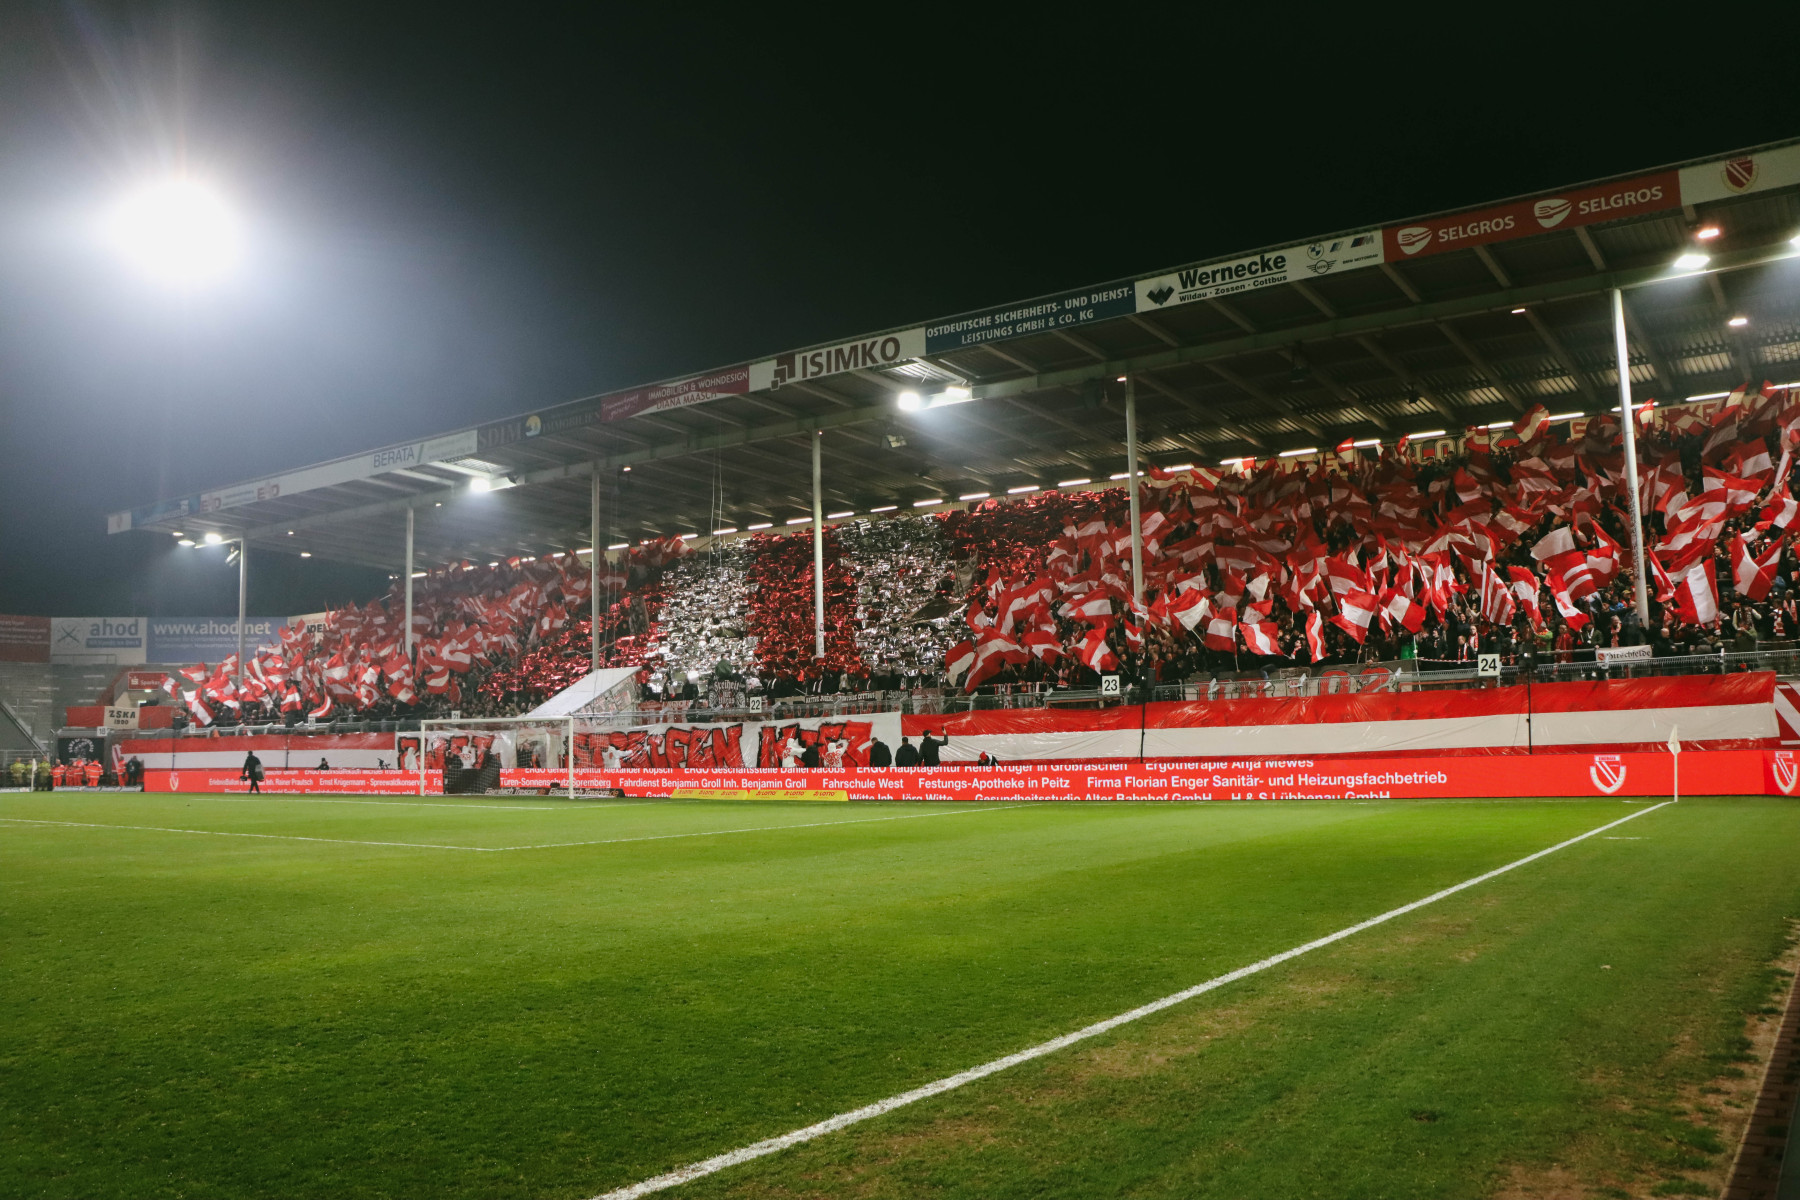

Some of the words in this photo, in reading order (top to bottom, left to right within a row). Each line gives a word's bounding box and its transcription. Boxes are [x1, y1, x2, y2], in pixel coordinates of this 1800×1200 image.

[1580, 186, 1663, 215] SELGROS
[1438, 216, 1515, 242] SELGROS
[1178, 254, 1287, 289] Wernecke
[1179, 290, 1208, 302] Wildau
[1214, 283, 1246, 295] Zossen
[1252, 275, 1288, 288] Cottbus
[926, 315, 992, 338] OSTDEUTSCHE
[994, 302, 1062, 324] SICHERHEITS-
[1064, 296, 1088, 310] UND
[1091, 286, 1133, 304] DIENST-
[961, 326, 1013, 345] LEISTUNGS
[1016, 319, 1045, 333] GMBH
[1048, 316, 1055, 327] &
[1058, 313, 1076, 325] CO.
[1079, 309, 1094, 321] KG
[801, 336, 901, 379] ISIMKO
[648, 384, 689, 401] IMMOBILIEN
[691, 382, 696, 391] &
[698, 370, 748, 389] WOHNDESIGN
[656, 399, 682, 410] DIANA
[683, 392, 717, 405] MAASCH
[373, 446, 414, 468] BERATA
[90, 619, 138, 636] ahod
[153, 620, 271, 635] www.ahodnet
[1480, 657, 1498, 672] 24
[1104, 679, 1118, 692] 23
[751, 700, 760, 710] 22
[109, 710, 136, 719] ZSKA
[370, 778, 427, 787] Spreewaldkonservn
[620, 778, 659, 787] Fahrdienst
[662, 778, 699, 789] Benjamin
[702, 778, 721, 788] Groll
[724, 779, 739, 788] Inh.
[742, 778, 783, 790] Benjamin
[785, 778, 807, 788] Groll
[823, 778, 876, 788] Fahrschule
[878, 778, 904, 788] West
[919, 778, 1025, 790] Festungs-Apotheke
[1028, 778, 1038, 788] in
[1042, 777, 1070, 788] Peitz
[1088, 777, 1121, 787] Firma
[1125, 776, 1167, 788] Florian
[1171, 776, 1209, 790] Enger
[1213, 774, 1264, 787] Sanitär-
[1268, 775, 1294, 786] und
[1298, 771, 1448, 788] Heizungsfachbetrieb
